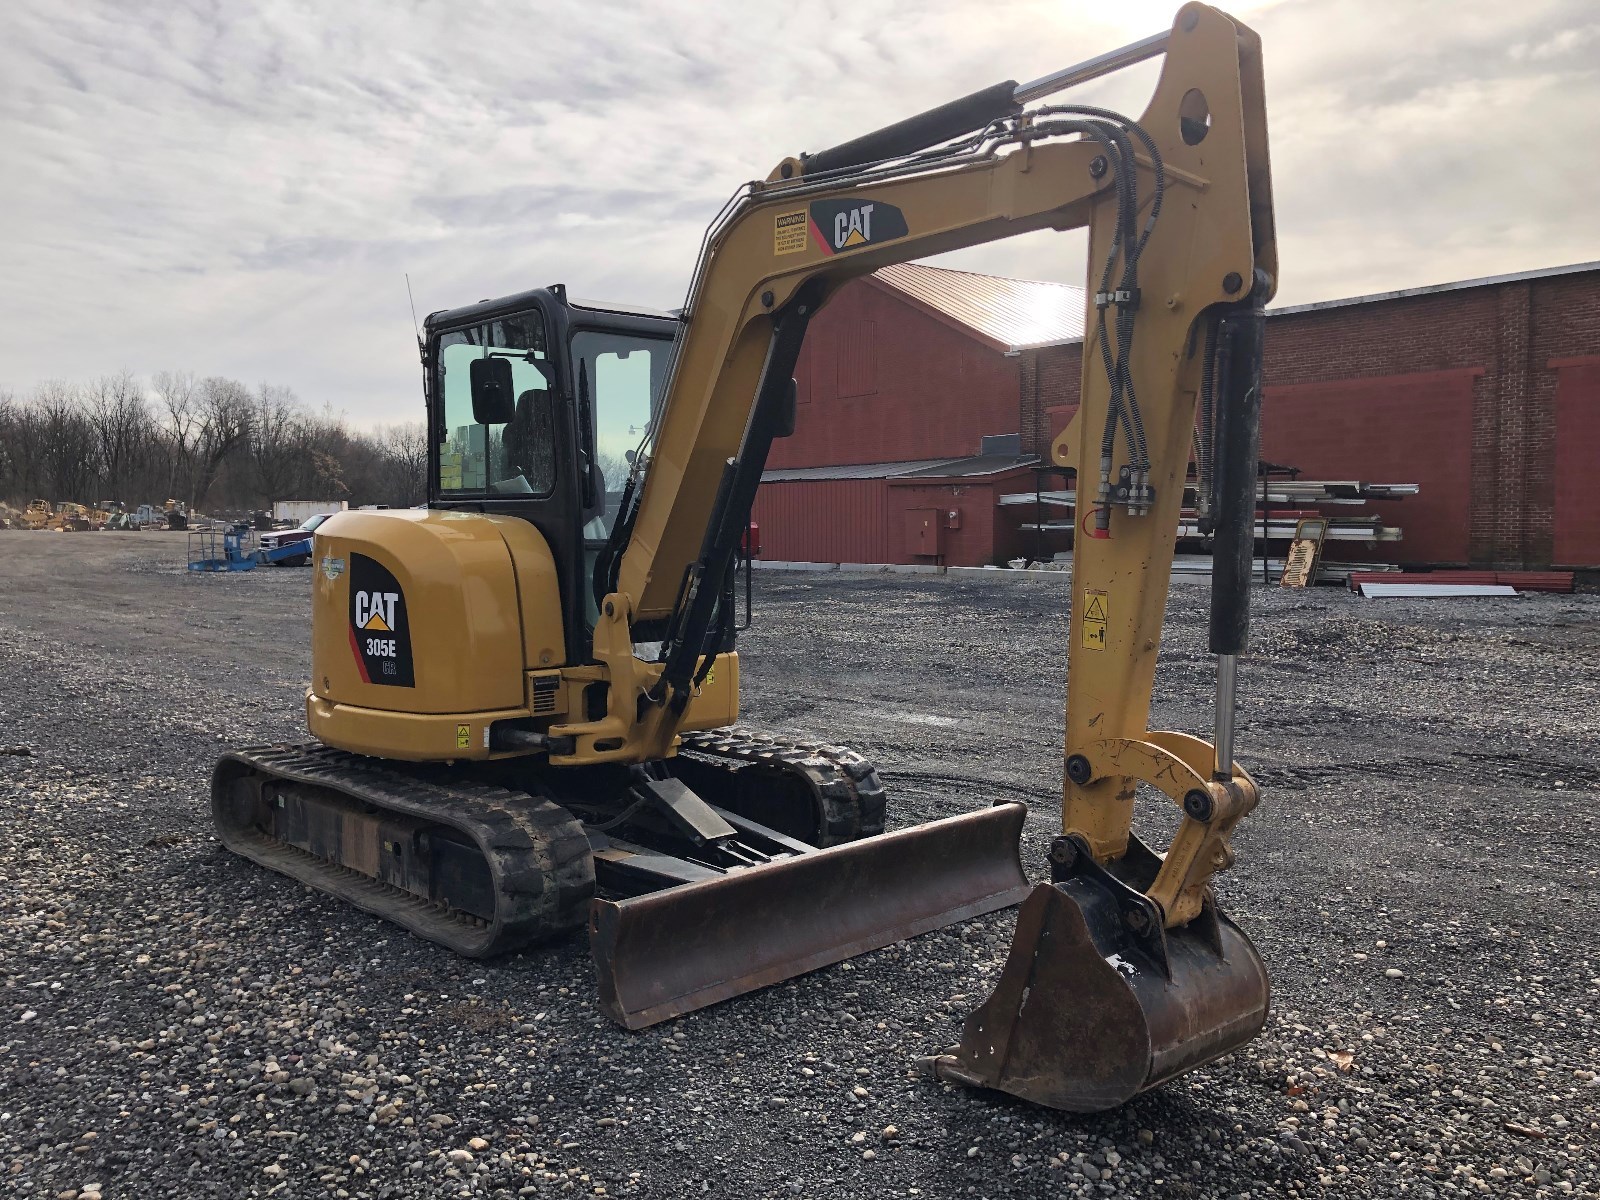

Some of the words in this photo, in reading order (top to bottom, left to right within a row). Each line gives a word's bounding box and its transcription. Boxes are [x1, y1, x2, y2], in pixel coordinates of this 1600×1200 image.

[777, 214, 805, 227] WARNING
[835, 204, 874, 249] CAT
[356, 591, 399, 631] CAT
[366, 638, 397, 657] 305E
[383, 661, 397, 675] CR
